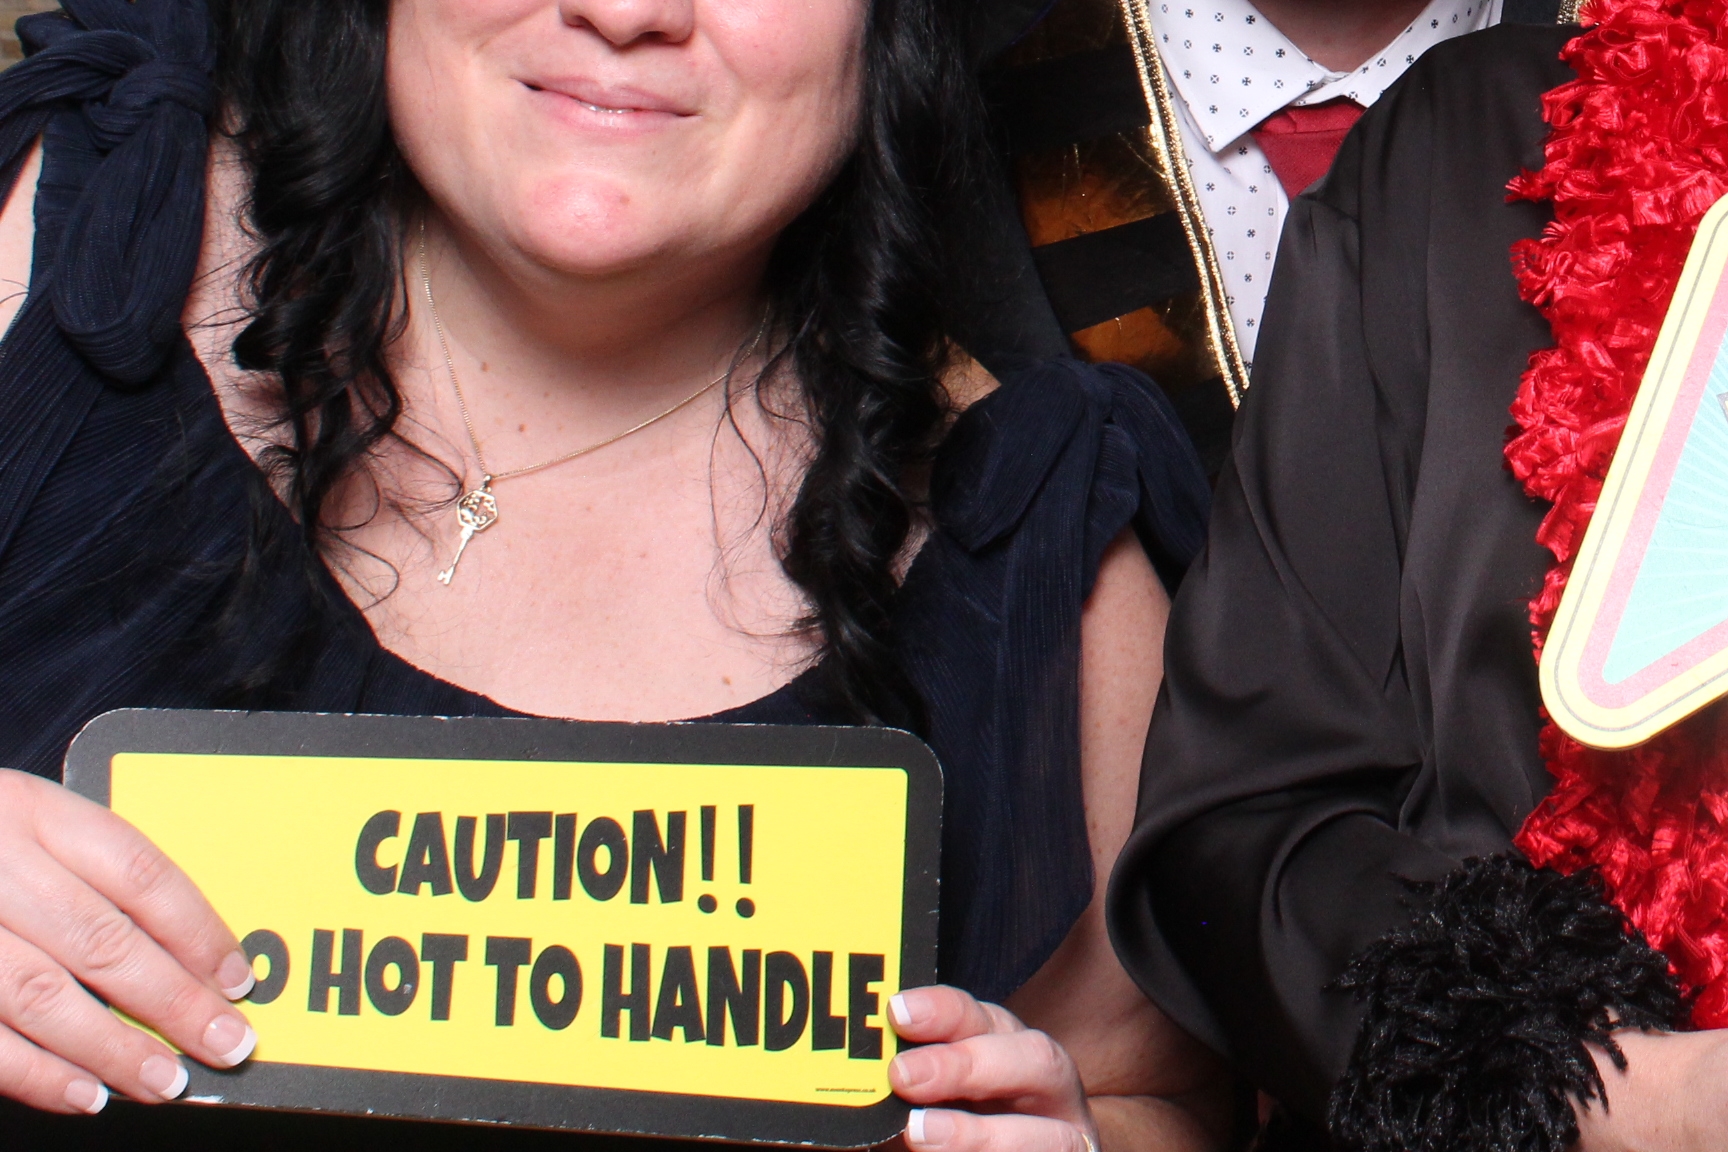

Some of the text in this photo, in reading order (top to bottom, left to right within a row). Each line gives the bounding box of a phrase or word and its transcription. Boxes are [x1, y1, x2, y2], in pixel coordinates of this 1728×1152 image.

[354, 804, 757, 920] CAUTION!!
[307, 927, 468, 1022] HOT
[484, 935, 583, 1032] TO
[600, 942, 885, 1061] HANDLE
